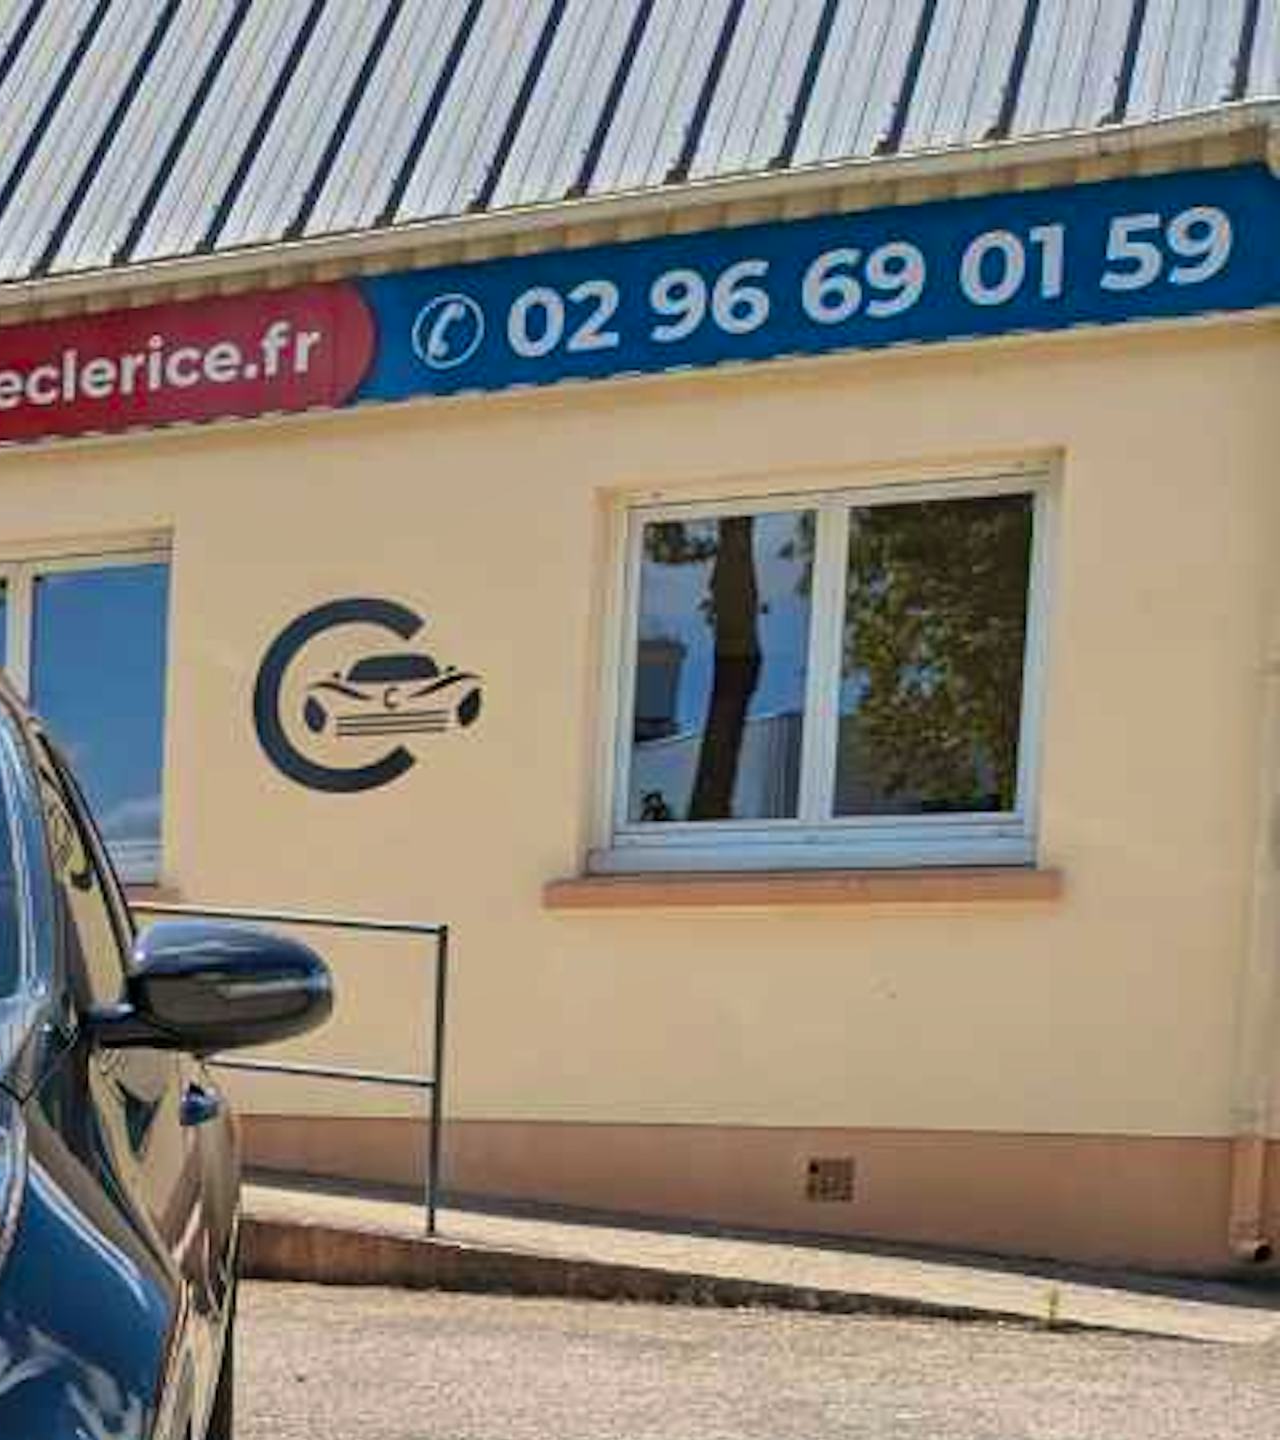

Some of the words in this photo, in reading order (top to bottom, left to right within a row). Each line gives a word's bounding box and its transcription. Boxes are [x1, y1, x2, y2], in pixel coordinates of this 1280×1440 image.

[507, 280, 620, 358] 02
[650, 260, 770, 341] 96
[802, 242, 925, 324] 69
[960, 224, 1063, 305] 01
[1100, 207, 1232, 290] 59
